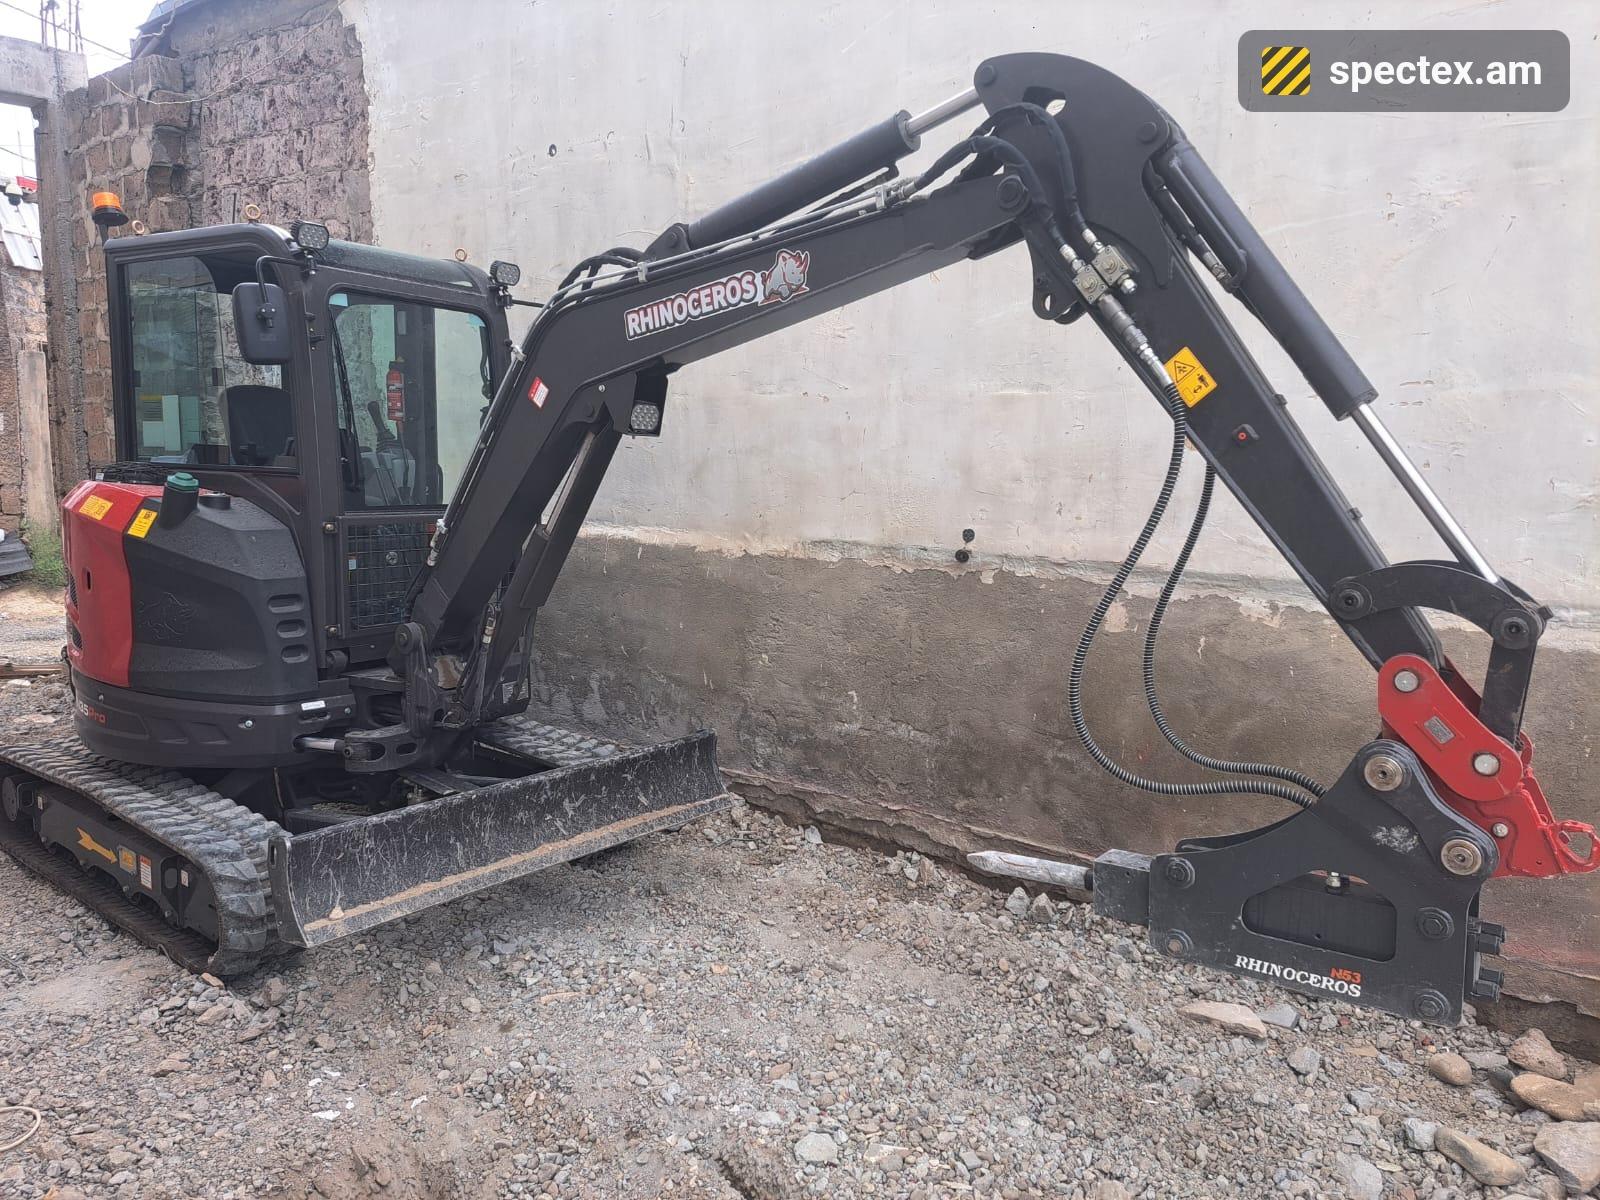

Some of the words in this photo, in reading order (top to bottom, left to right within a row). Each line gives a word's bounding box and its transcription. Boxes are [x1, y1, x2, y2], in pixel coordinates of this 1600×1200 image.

[625, 272, 758, 338] RHINOCEROS
[1234, 954, 1362, 998] RHINOCEROS
[1330, 967, 1362, 984] N53
